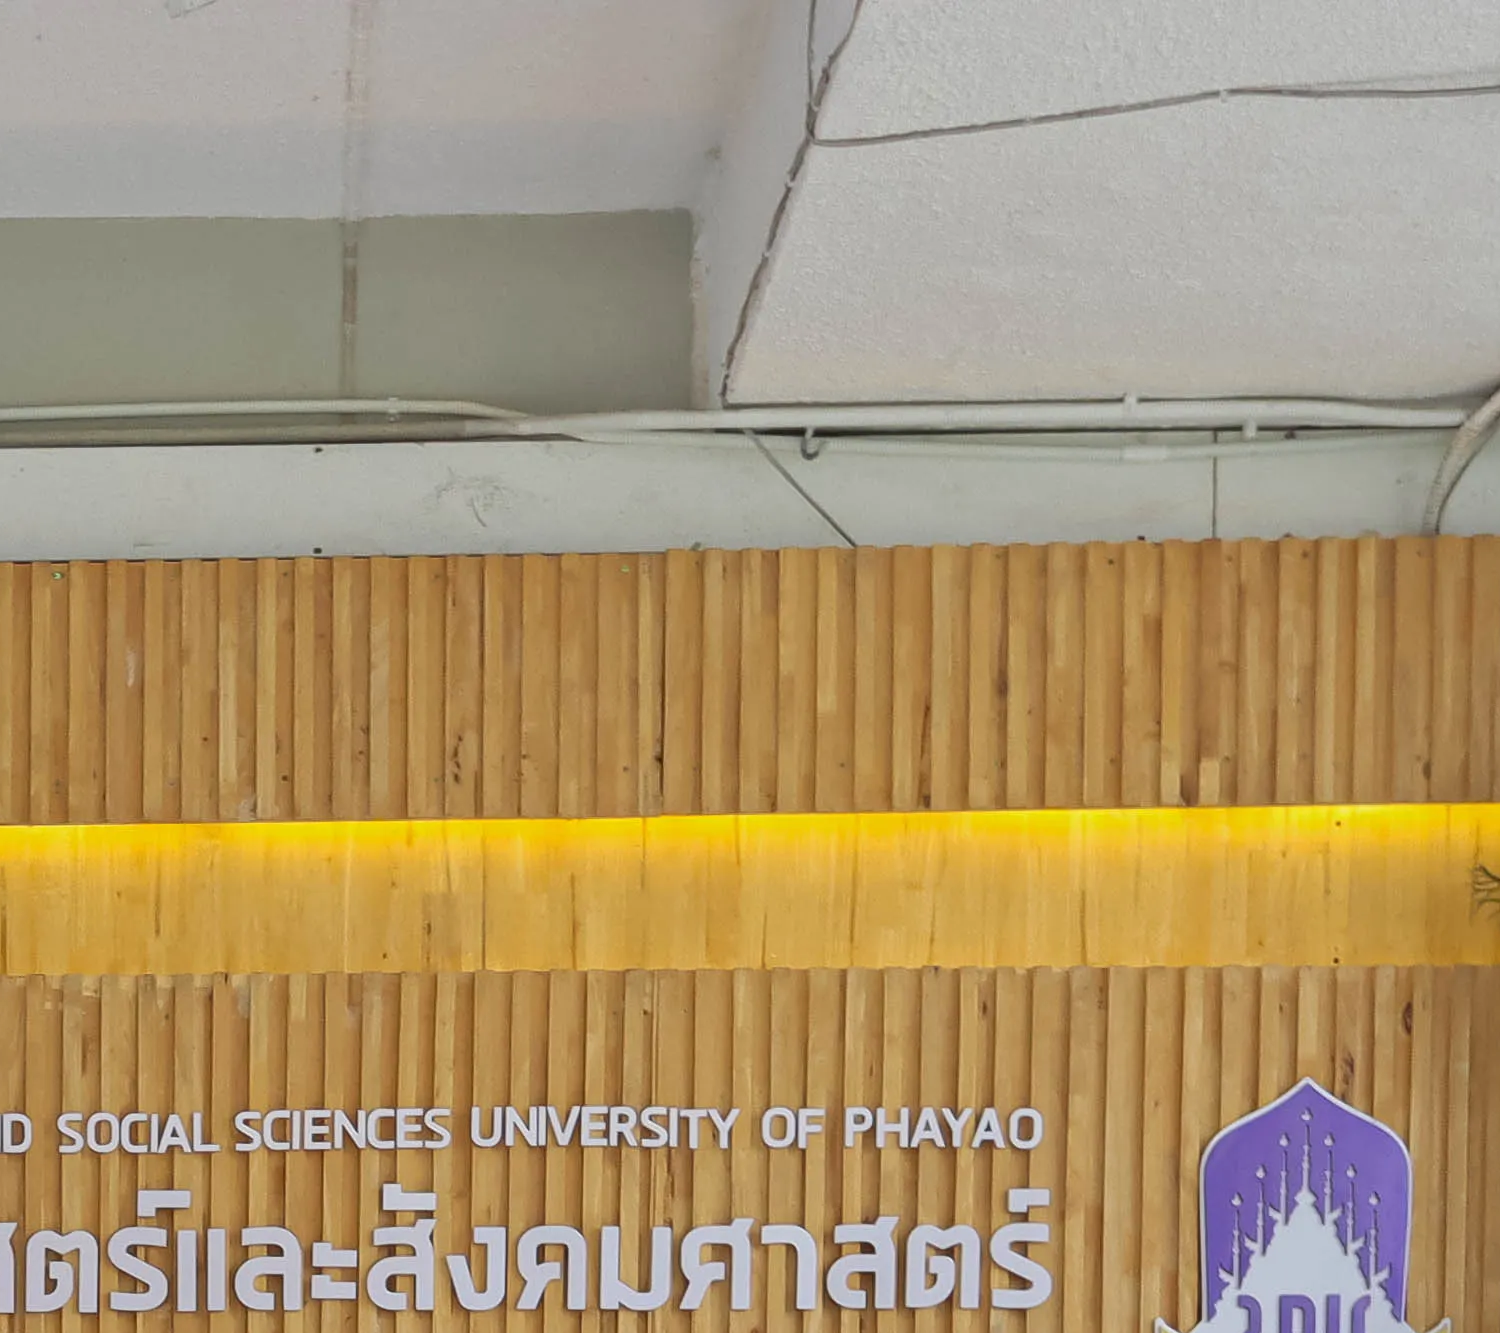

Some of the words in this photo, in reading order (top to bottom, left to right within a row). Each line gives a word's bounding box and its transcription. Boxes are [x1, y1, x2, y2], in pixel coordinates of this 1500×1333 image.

[56, 1110, 222, 1155] SOCIAL
[233, 1106, 453, 1153] SCIENCES
[469, 1104, 742, 1151] UNIVERSITY
[760, 1105, 828, 1150] OF
[843, 1105, 1046, 1151] PHAYAO
